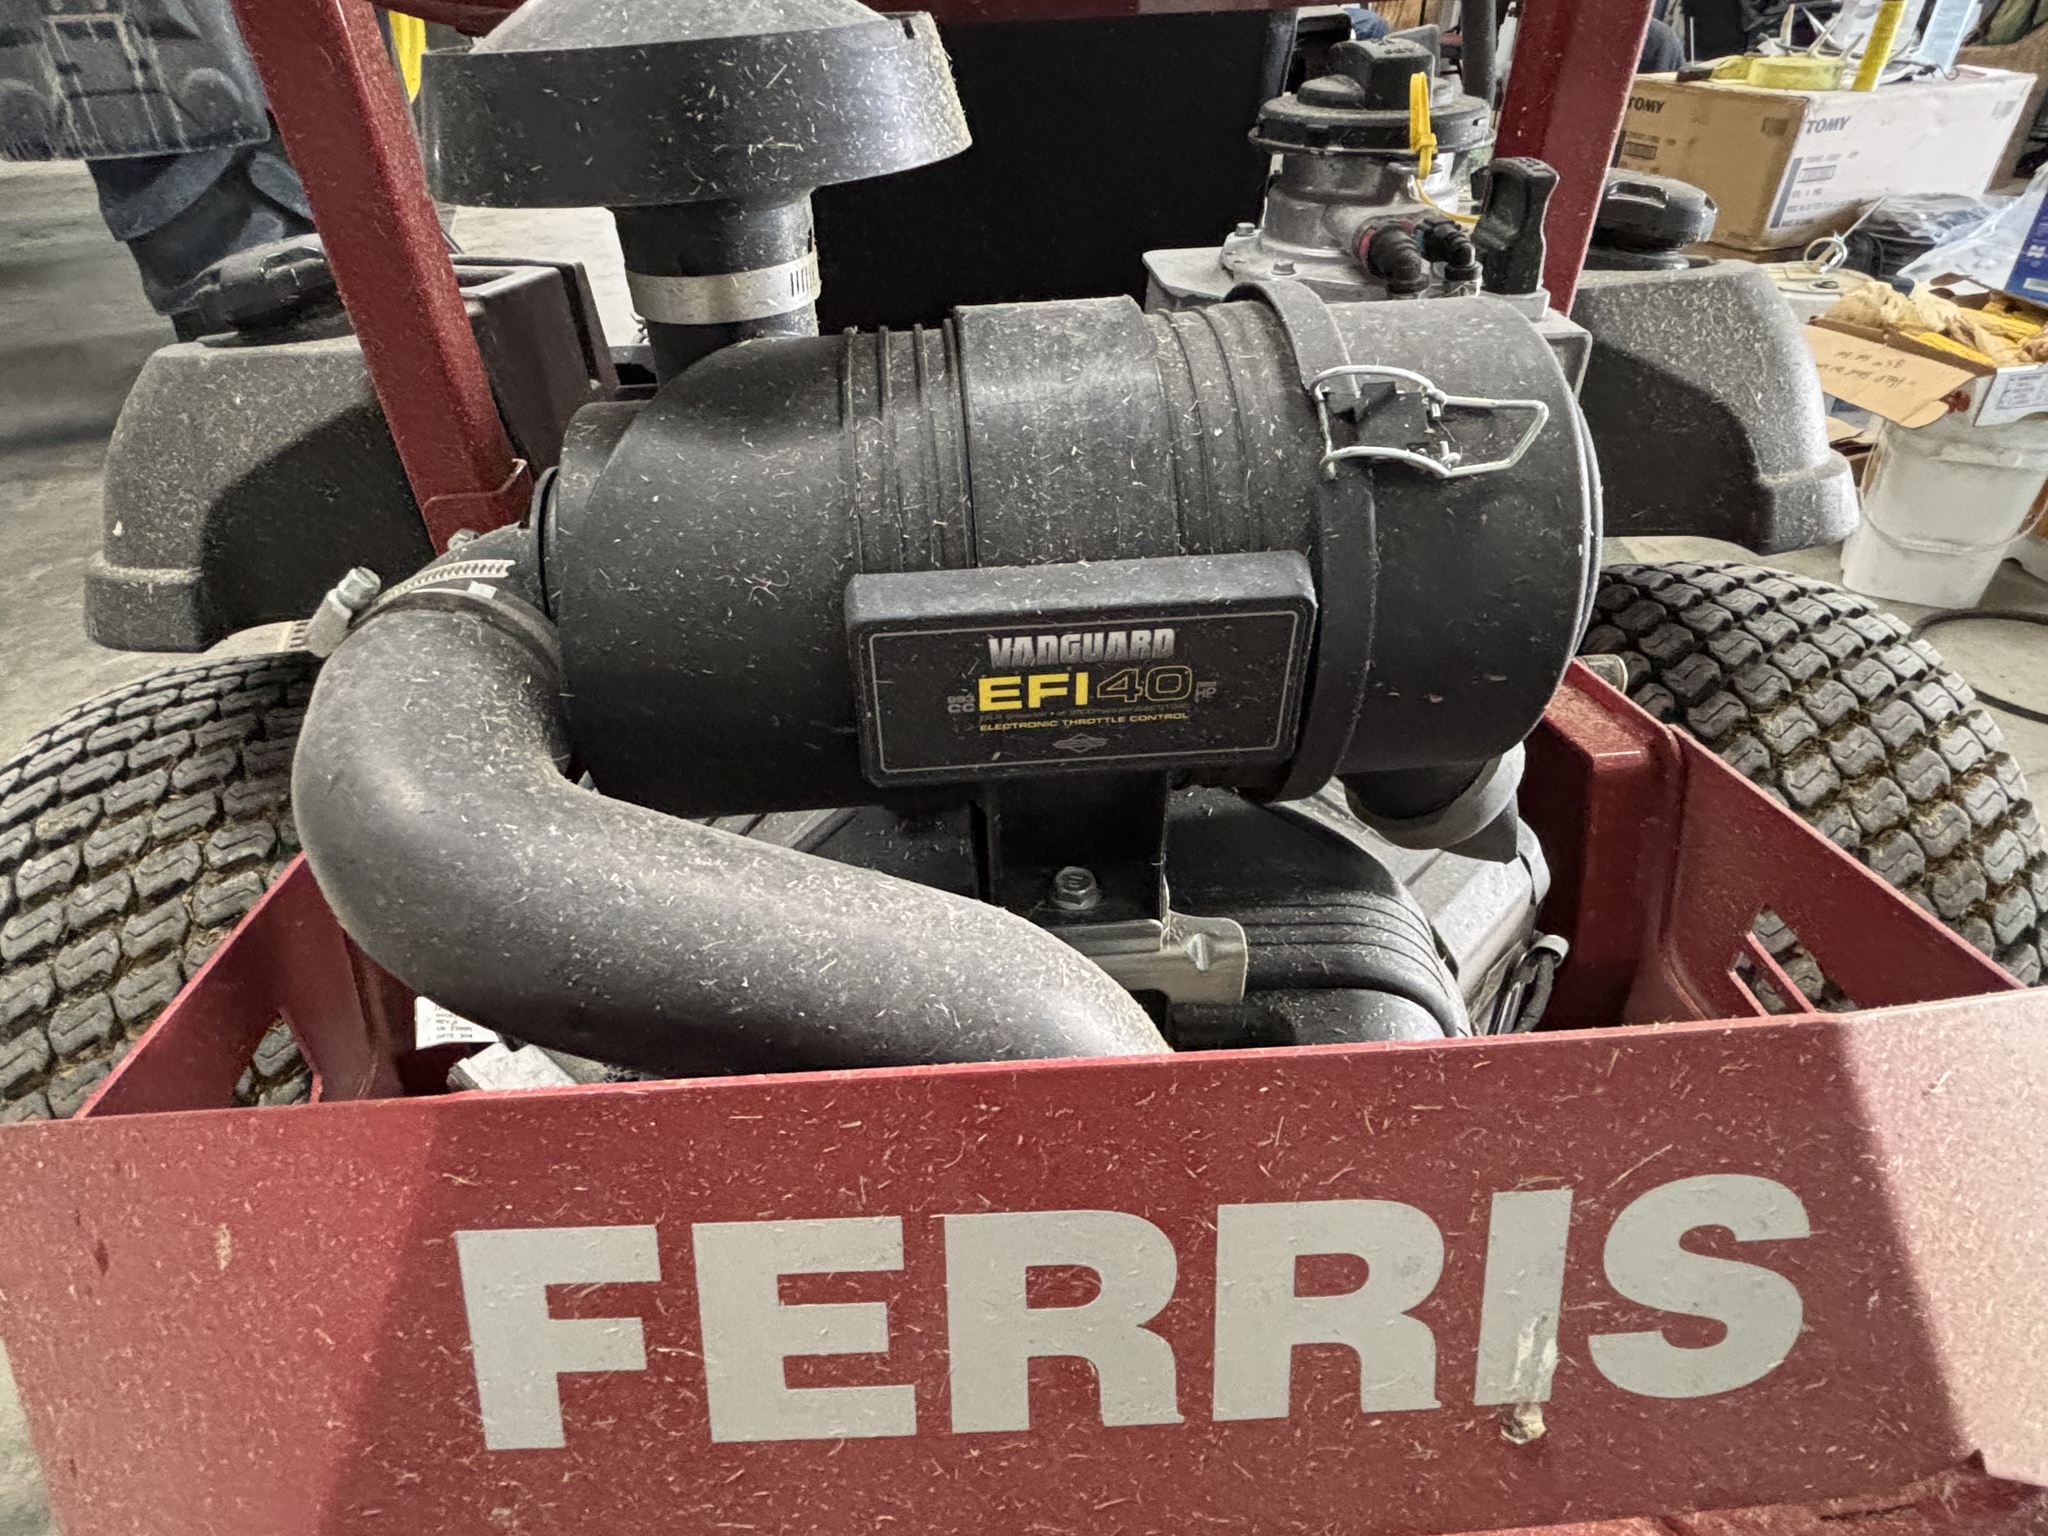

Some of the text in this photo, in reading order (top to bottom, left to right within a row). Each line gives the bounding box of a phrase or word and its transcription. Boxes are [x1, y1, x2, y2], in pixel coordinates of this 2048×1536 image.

[1628, 97, 1665, 113] TOMY
[1806, 116, 1852, 134] TOMY
[988, 628, 1175, 669] VANGUARD
[978, 671, 1089, 712] EFI
[1096, 665, 1192, 703] 40
[947, 703, 975, 713] CC
[980, 712, 1190, 731] ELECTRONIC THROTTLE CONTROL
[455, 1173, 1811, 1451] FERRIS
